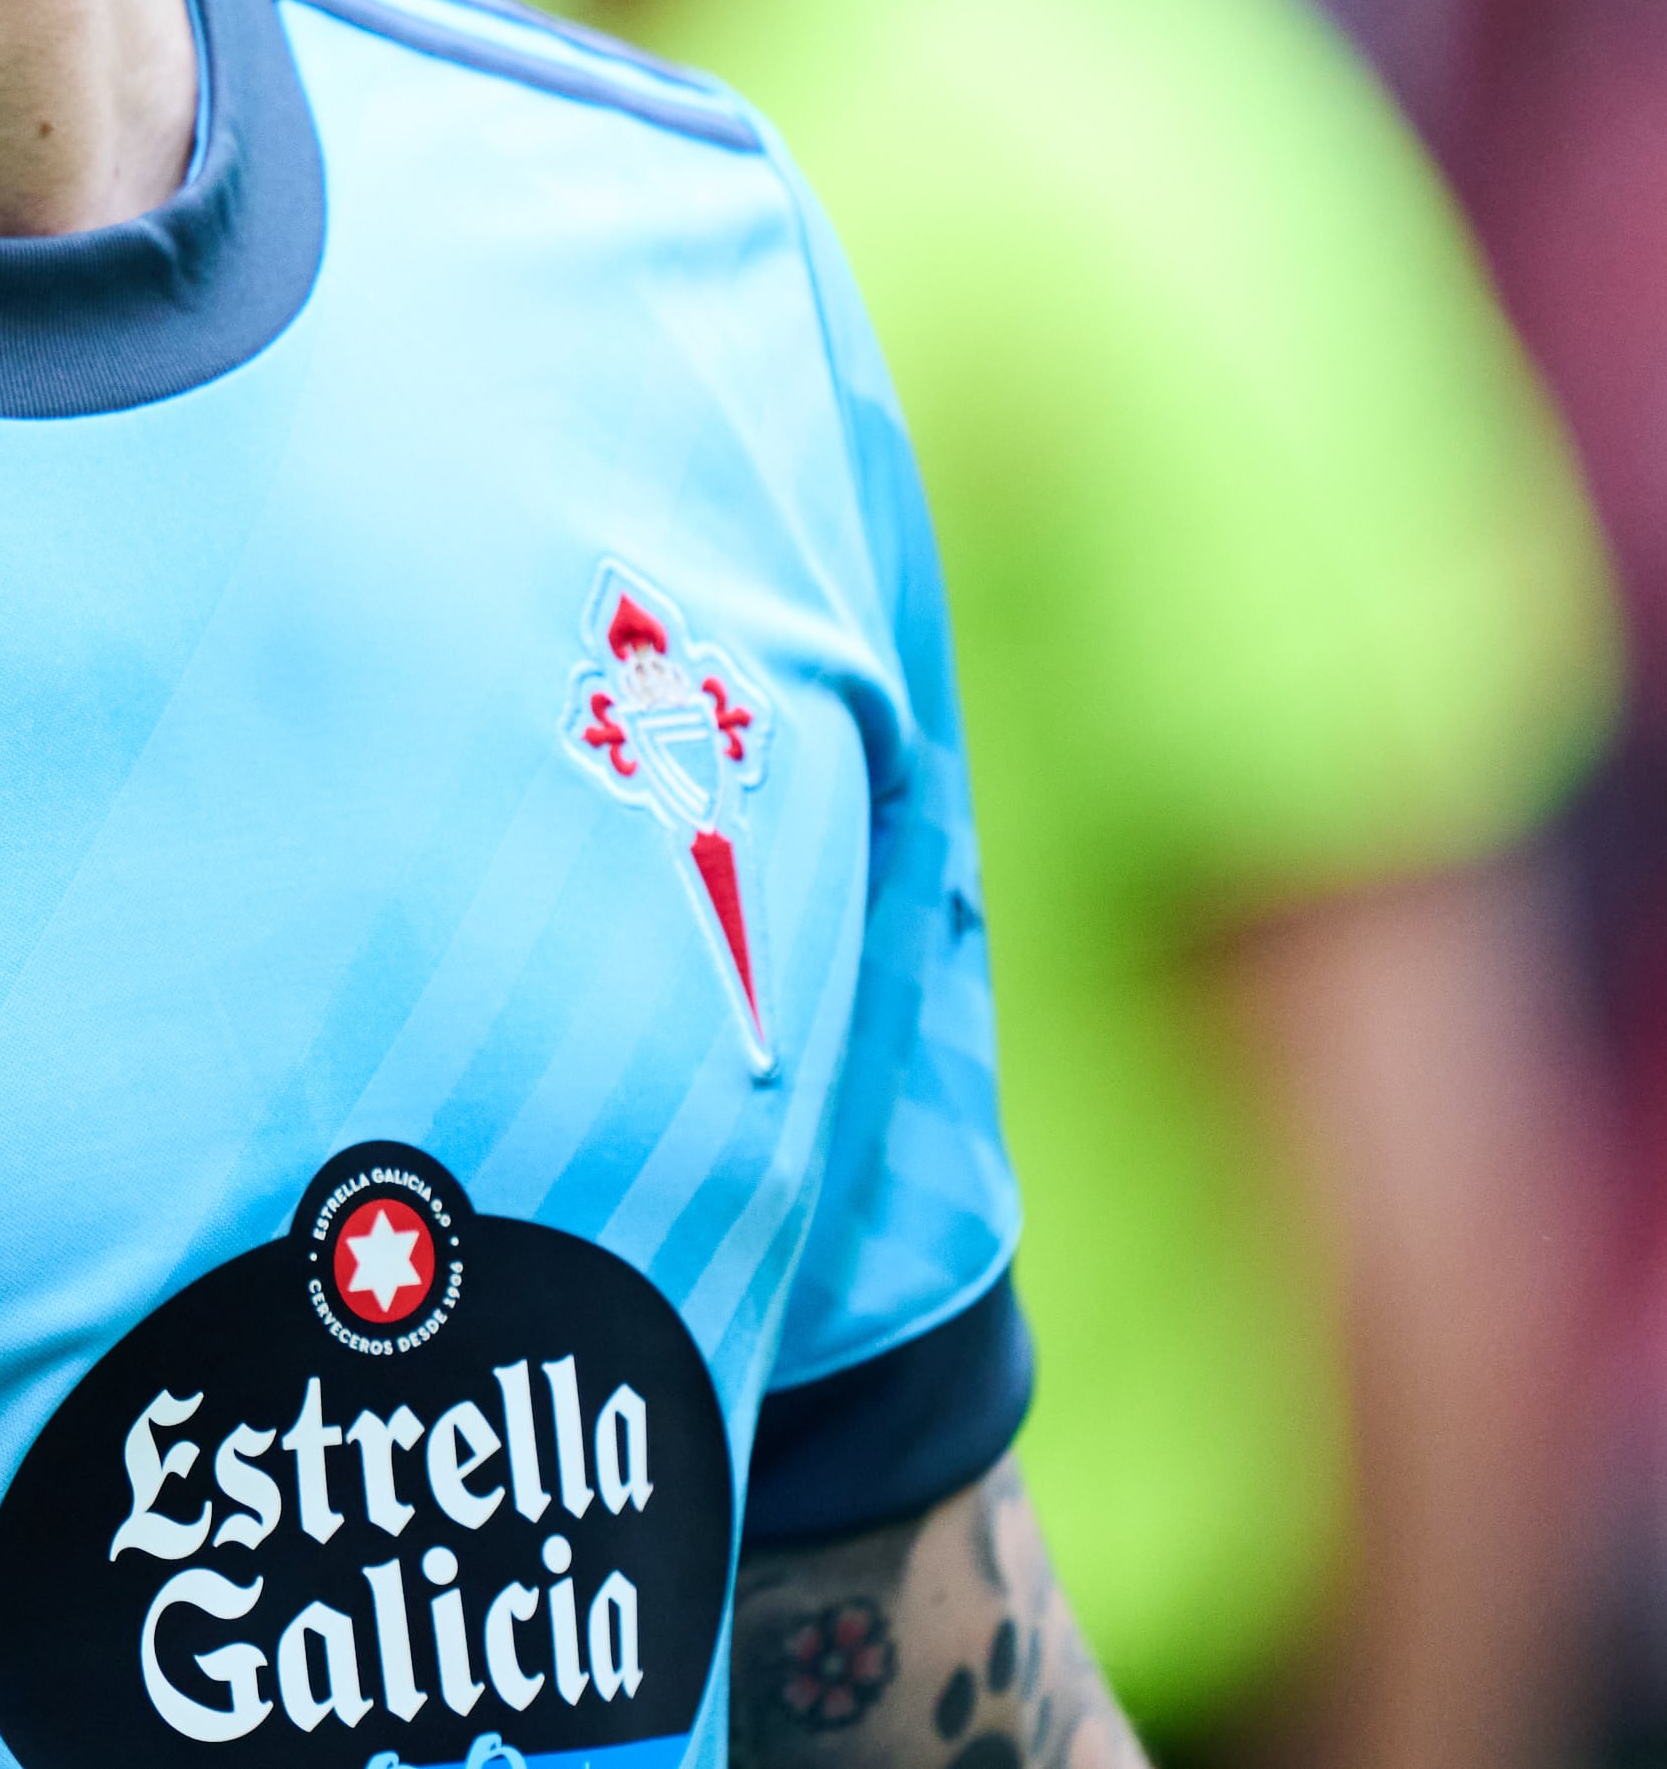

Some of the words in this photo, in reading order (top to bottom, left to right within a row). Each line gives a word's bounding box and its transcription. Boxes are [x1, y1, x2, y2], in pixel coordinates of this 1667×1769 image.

[313, 1173, 371, 1241] ESTRELLA
[371, 1168, 432, 1202] GALICIA
[308, 1279, 394, 1356] CERVECEROS
[397, 1308, 449, 1353] DESDE
[443, 1261, 464, 1309] 1906
[110, 1353, 654, 1563] Estrella
[141, 1534, 644, 1743] Galicia
